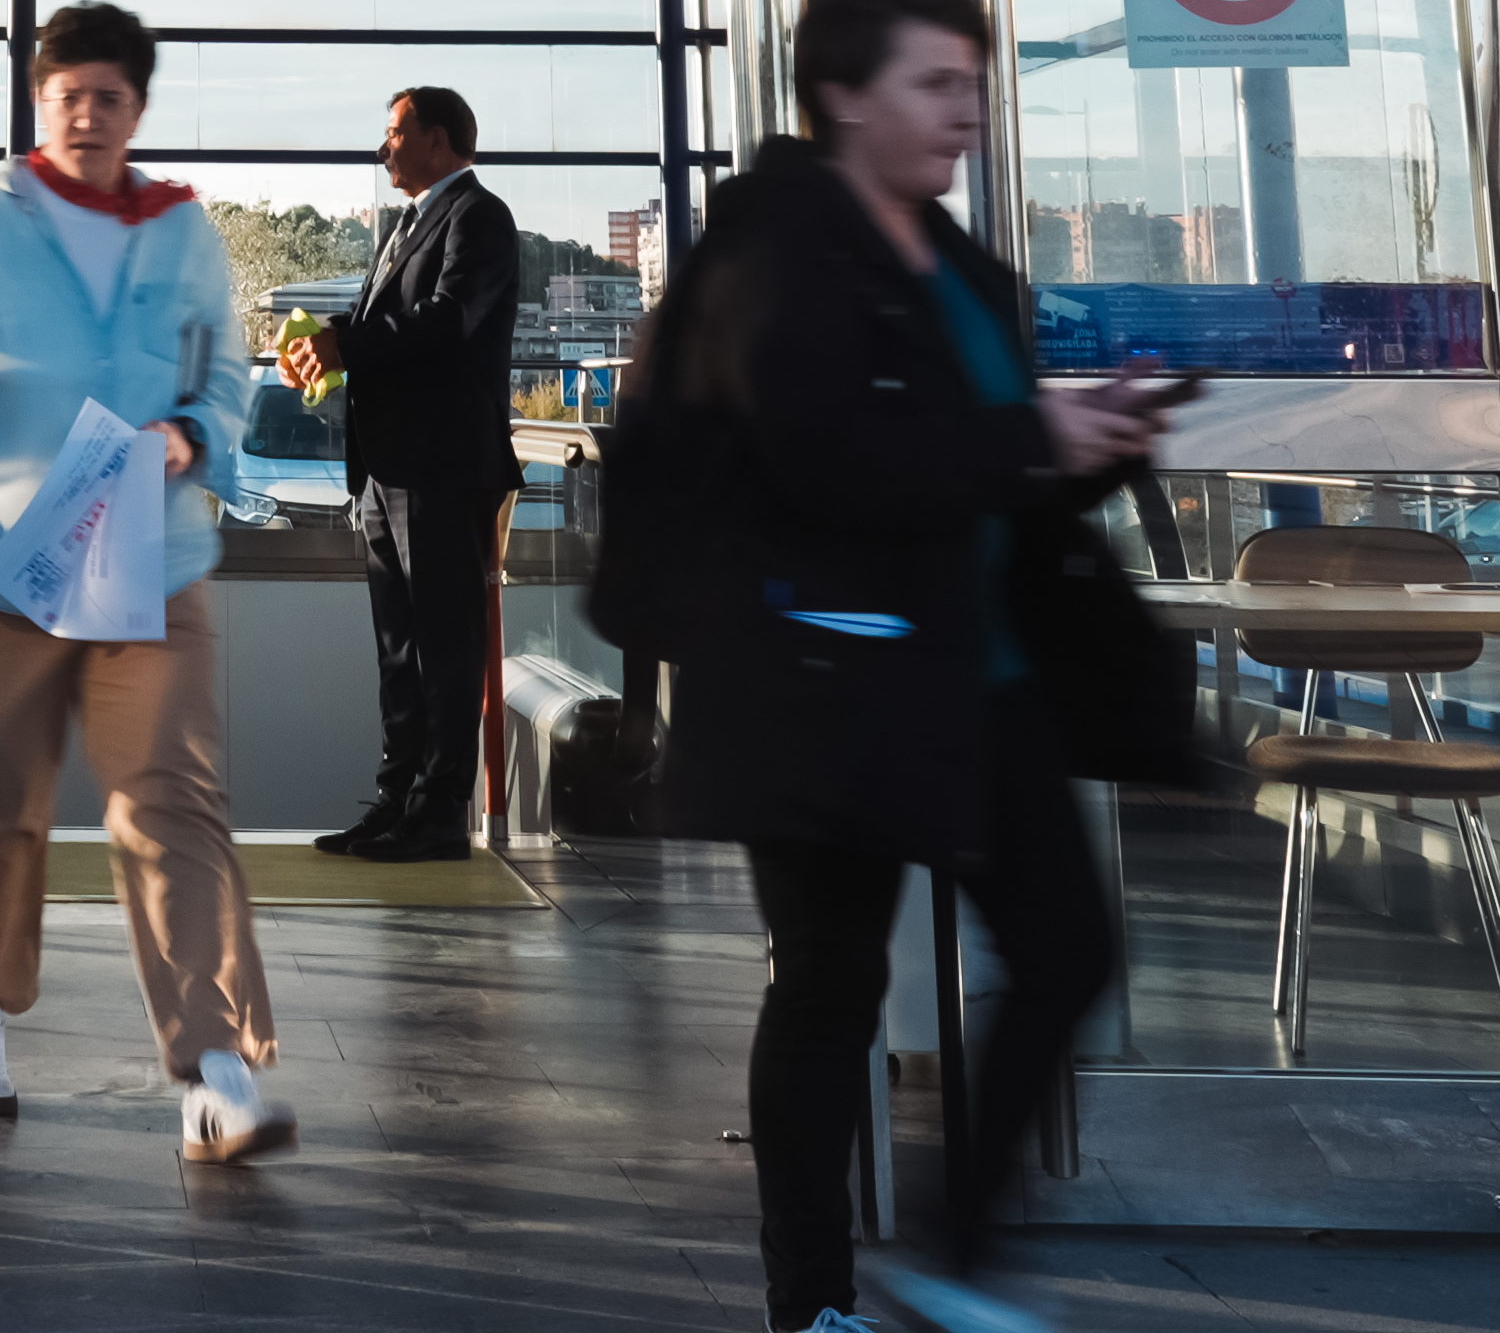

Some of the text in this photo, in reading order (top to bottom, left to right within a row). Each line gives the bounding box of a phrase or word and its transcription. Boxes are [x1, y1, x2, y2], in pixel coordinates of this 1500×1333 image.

[1199, 34, 1235, 42] ACCESO
[1236, 34, 1256, 42] CON
[1257, 33, 1293, 41] GLOBOS
